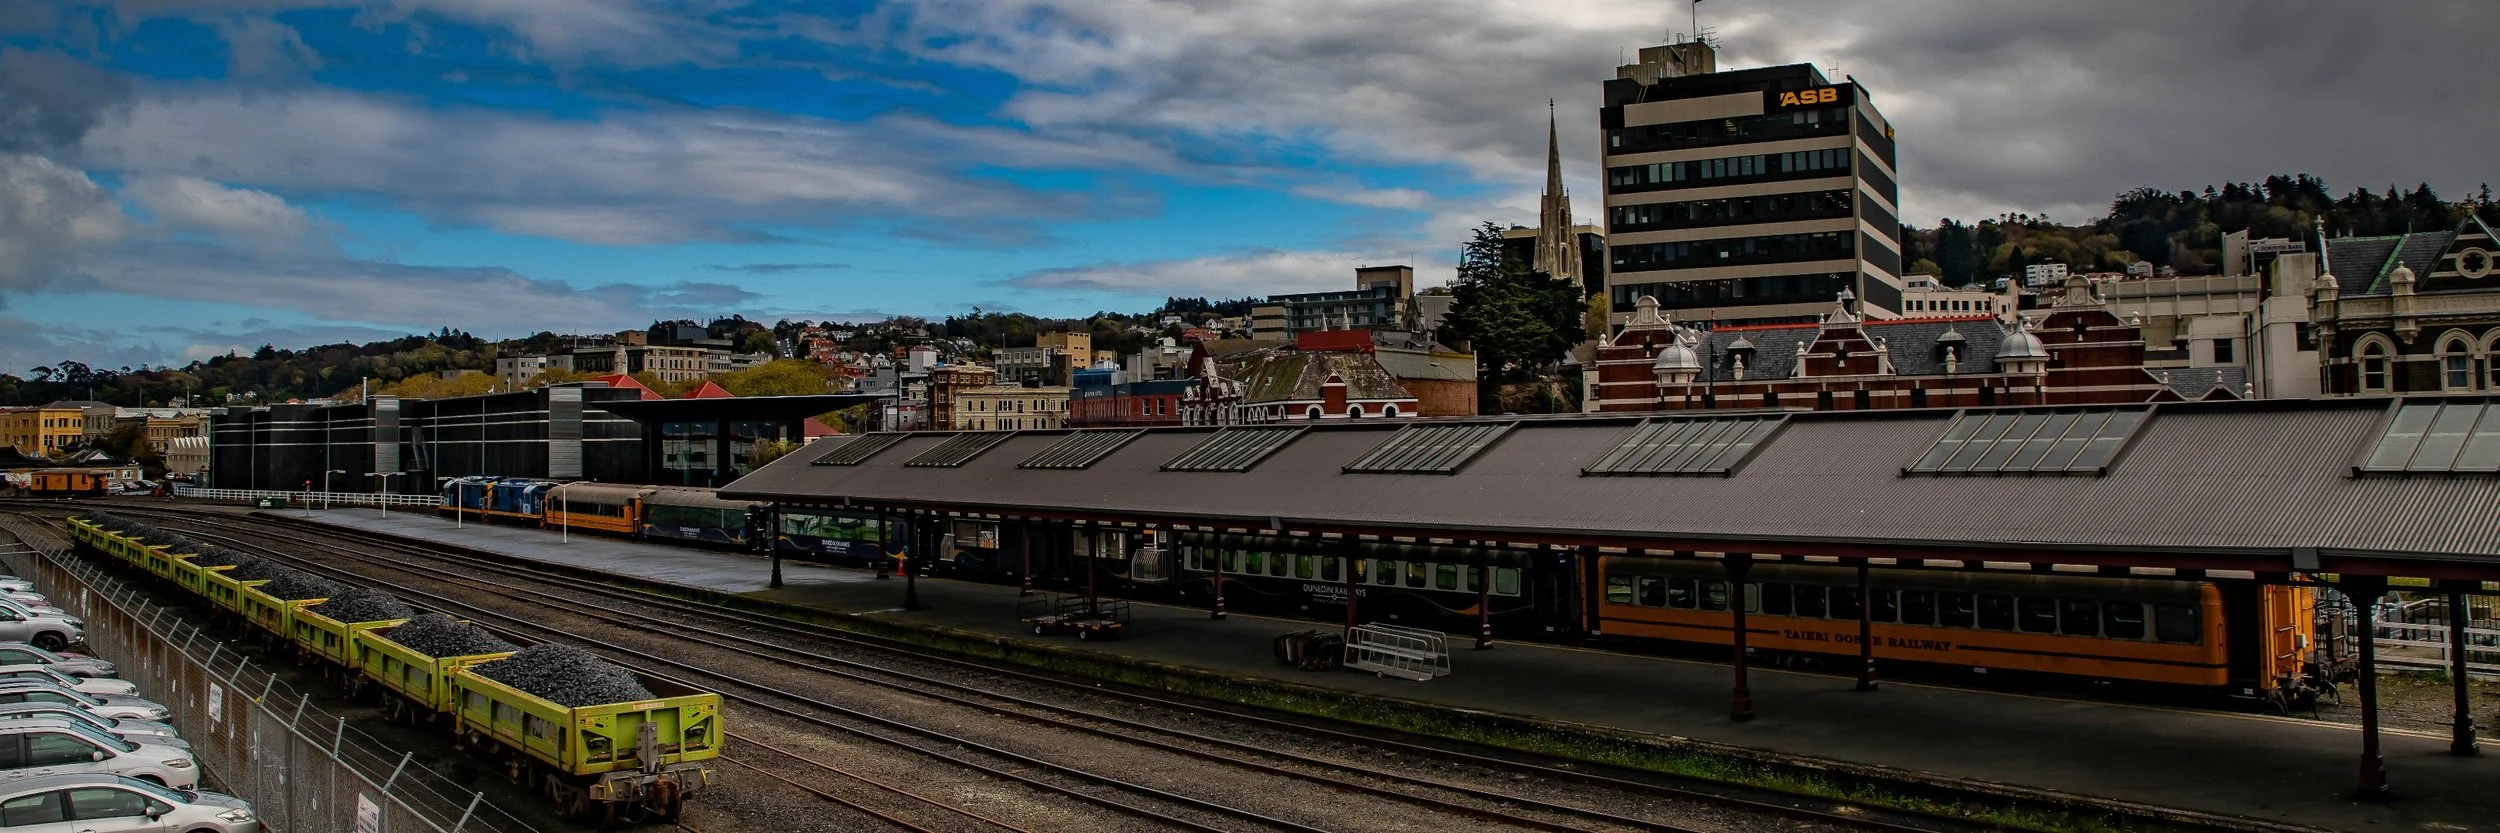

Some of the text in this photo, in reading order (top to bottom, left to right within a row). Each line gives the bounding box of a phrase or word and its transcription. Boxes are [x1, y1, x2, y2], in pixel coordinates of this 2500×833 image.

[1780, 88, 1838, 107] ASB
[1303, 584, 1367, 597] DUNEDIN RAILAYS
[1783, 629, 1951, 651] TAIERI GORE RAILWAY
